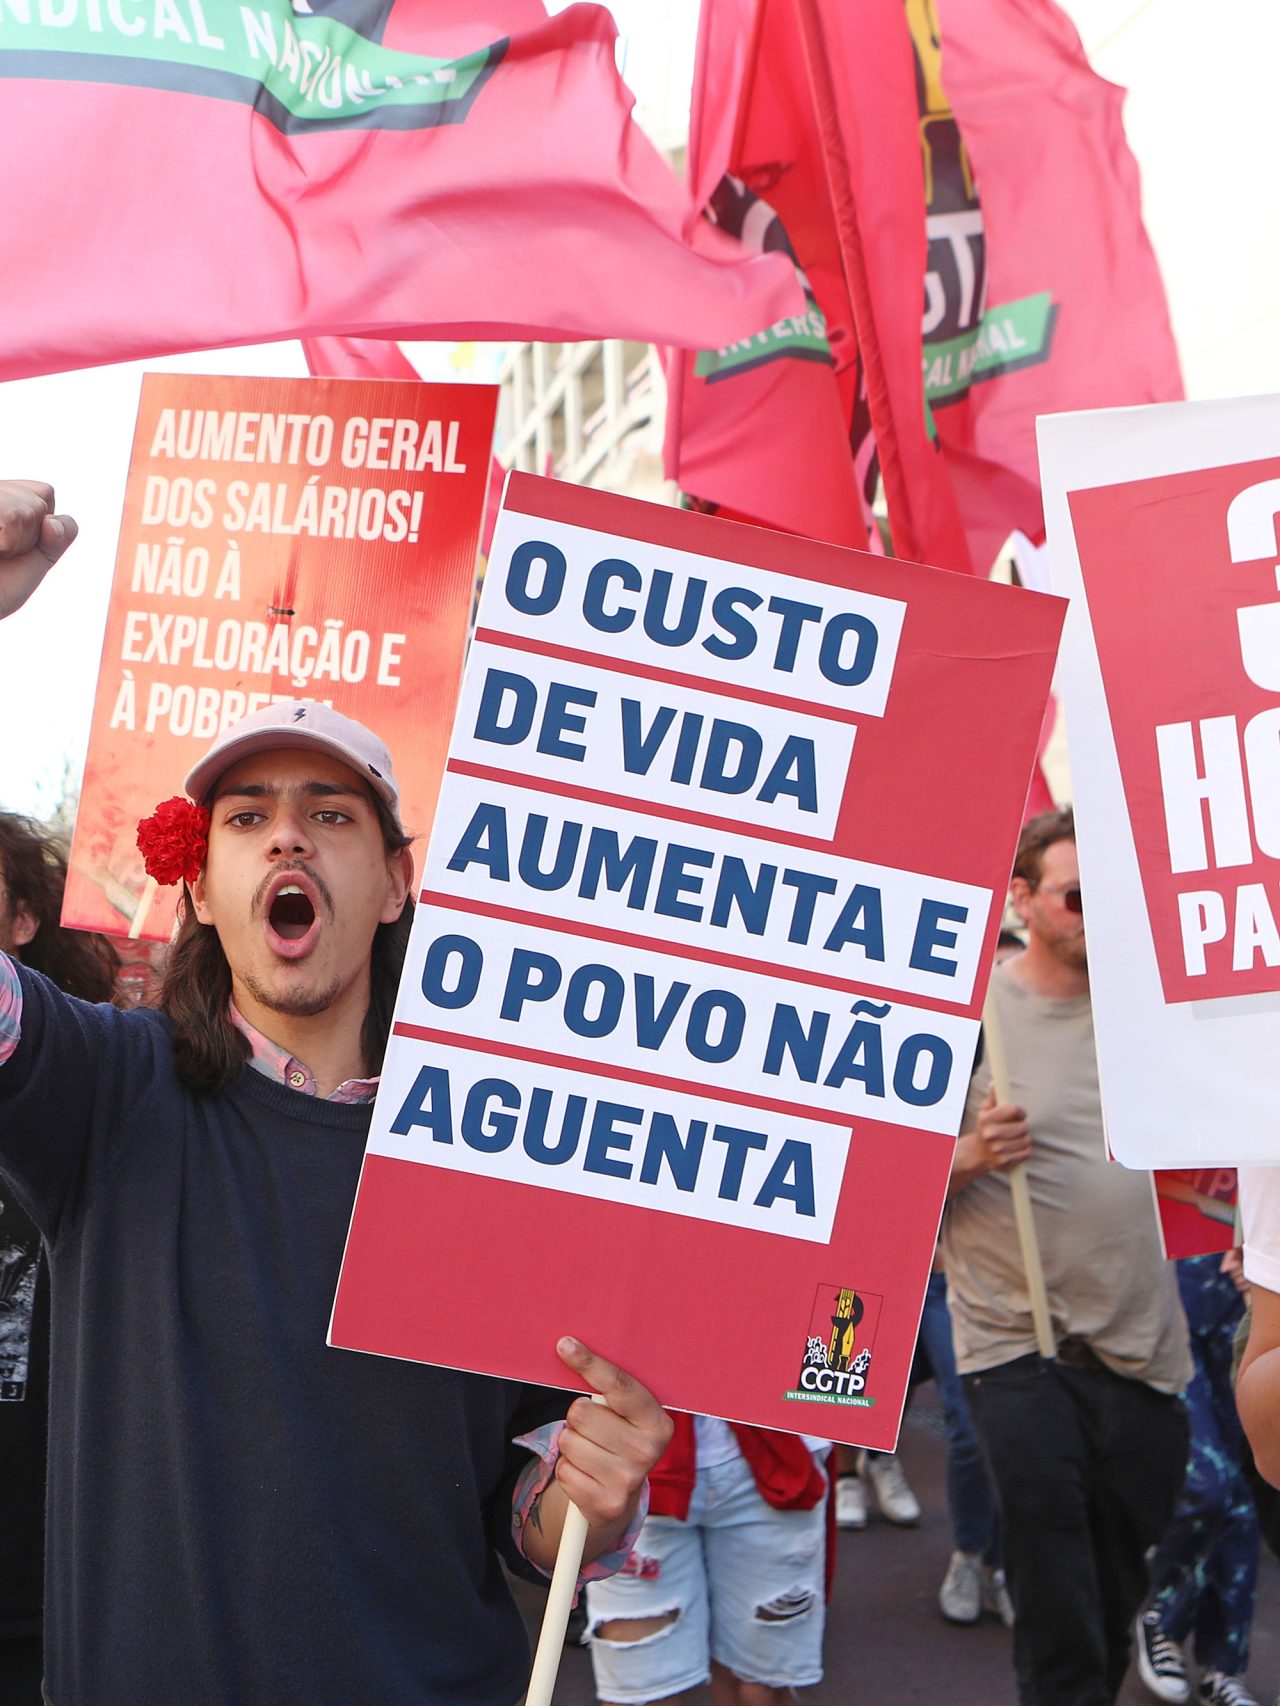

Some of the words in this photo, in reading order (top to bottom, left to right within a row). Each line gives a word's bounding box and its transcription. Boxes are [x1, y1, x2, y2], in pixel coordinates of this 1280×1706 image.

[149, 408, 333, 467] AUMENTO
[342, 417, 466, 473] GERAL
[142, 476, 216, 531] DOS
[223, 475, 424, 543] SALÁRIOS!
[131, 536, 207, 597] NÃO
[215, 532, 241, 600] À
[122, 610, 371, 687] EXPLORAÇÃO
[377, 633, 407, 687] E
[506, 540, 567, 615] O
[582, 558, 879, 686] CUSTO
[110, 670, 135, 731] À
[474, 667, 598, 761] DE
[622, 697, 818, 813] VIDA
[446, 803, 885, 962] AUMENTA
[910, 898, 969, 977] E
[421, 934, 484, 1009] O
[500, 947, 747, 1063] POVO
[763, 1000, 953, 1106] NÃO
[389, 1065, 817, 1217] AGUENTA
[787, 1391, 835, 1403] INTERSINDICAL
[837, 1396, 869, 1407] NACIONAL
[801, 1366, 865, 1395] CGTP
